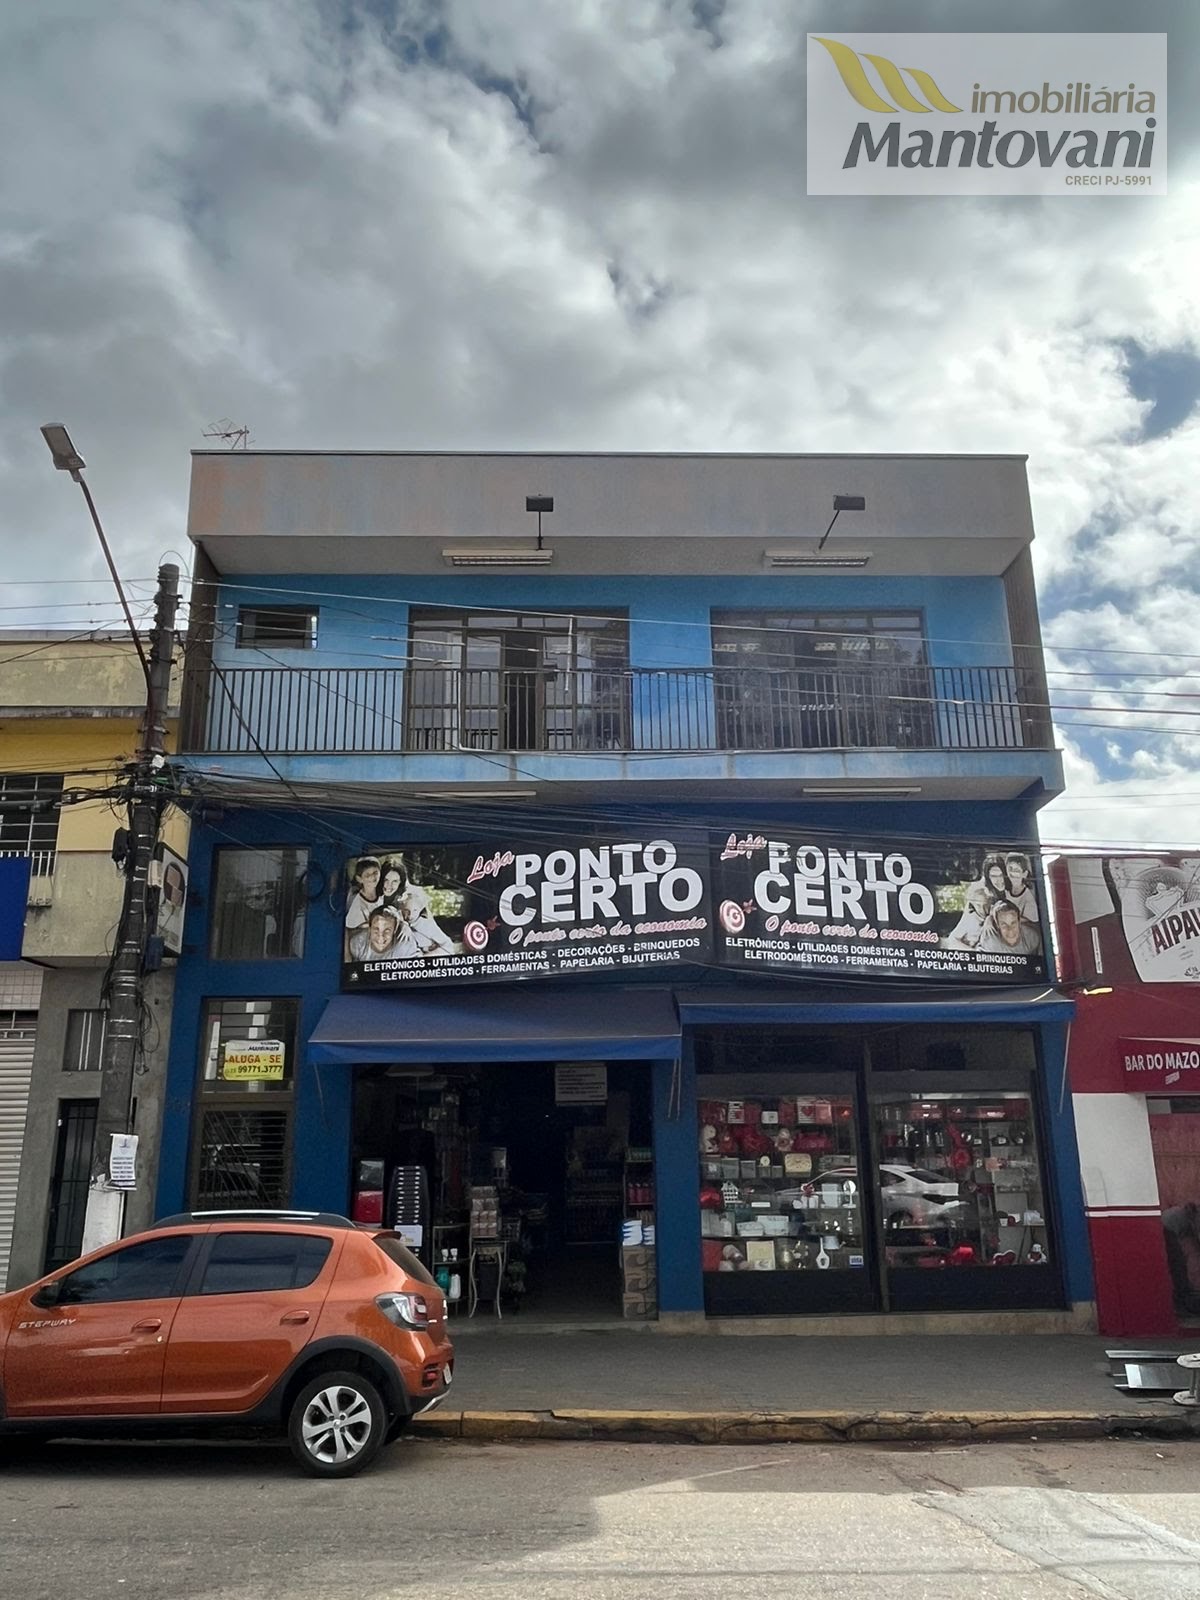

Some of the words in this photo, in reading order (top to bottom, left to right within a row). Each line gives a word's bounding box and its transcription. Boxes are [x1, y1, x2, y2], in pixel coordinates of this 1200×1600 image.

[720, 832, 767, 860] Loja
[467, 850, 515, 883] Loja
[515, 839, 677, 887] PONTO
[768, 841, 912, 886] PONTO
[499, 867, 703, 926] CERTO
[754, 869, 934, 924] CERTO
[508, 927, 523, 945] O
[609, 920, 632, 936] da
[634, 916, 707, 934] economia
[765, 915, 779, 932] O
[780, 920, 820, 936] ponto
[822, 921, 857, 937] certo
[858, 924, 878, 939] da
[880, 928, 938, 943] economia
[364, 958, 425, 972] ELETRÔNICOS
[432, 954, 484, 967] UTILIDADES
[487, 950, 547, 963] DOMÉSTICAS
[558, 944, 625, 958] DECORAÇÕES
[633, 938, 700, 951] BRINQUEDOS
[725, 937, 790, 950] ELETRÔNICOS
[797, 942, 848, 954] UTILIDADES
[850, 945, 905, 957] DOMÉSTICAS
[914, 950, 970, 961] DECORAÇÕES
[976, 954, 1027, 965] BRINQUEDOS
[744, 950, 839, 964] ELETRODOMÉSTICOS
[846, 956, 908, 967] FERRAMENTAS
[917, 961, 962, 971] PAPELARIA
[968, 965, 1013, 974] BIJUTERIAS
[381, 966, 474, 981] ELETRODOMÉSTICOS
[481, 962, 549, 974] FERRAMENTAS
[560, 957, 614, 968] PAPELARIA
[622, 951, 681, 964] BIJUTERIAS
[229, 1055, 261, 1063] ALUGA
[269, 1055, 281, 1063] SE
[1125, 1055, 1145, 1071] BAR
[1146, 1053, 1163, 1070] DO
[1165, 1050, 1200, 1069] MAZO
[18, 1318, 76, 1329] STEPWAY
